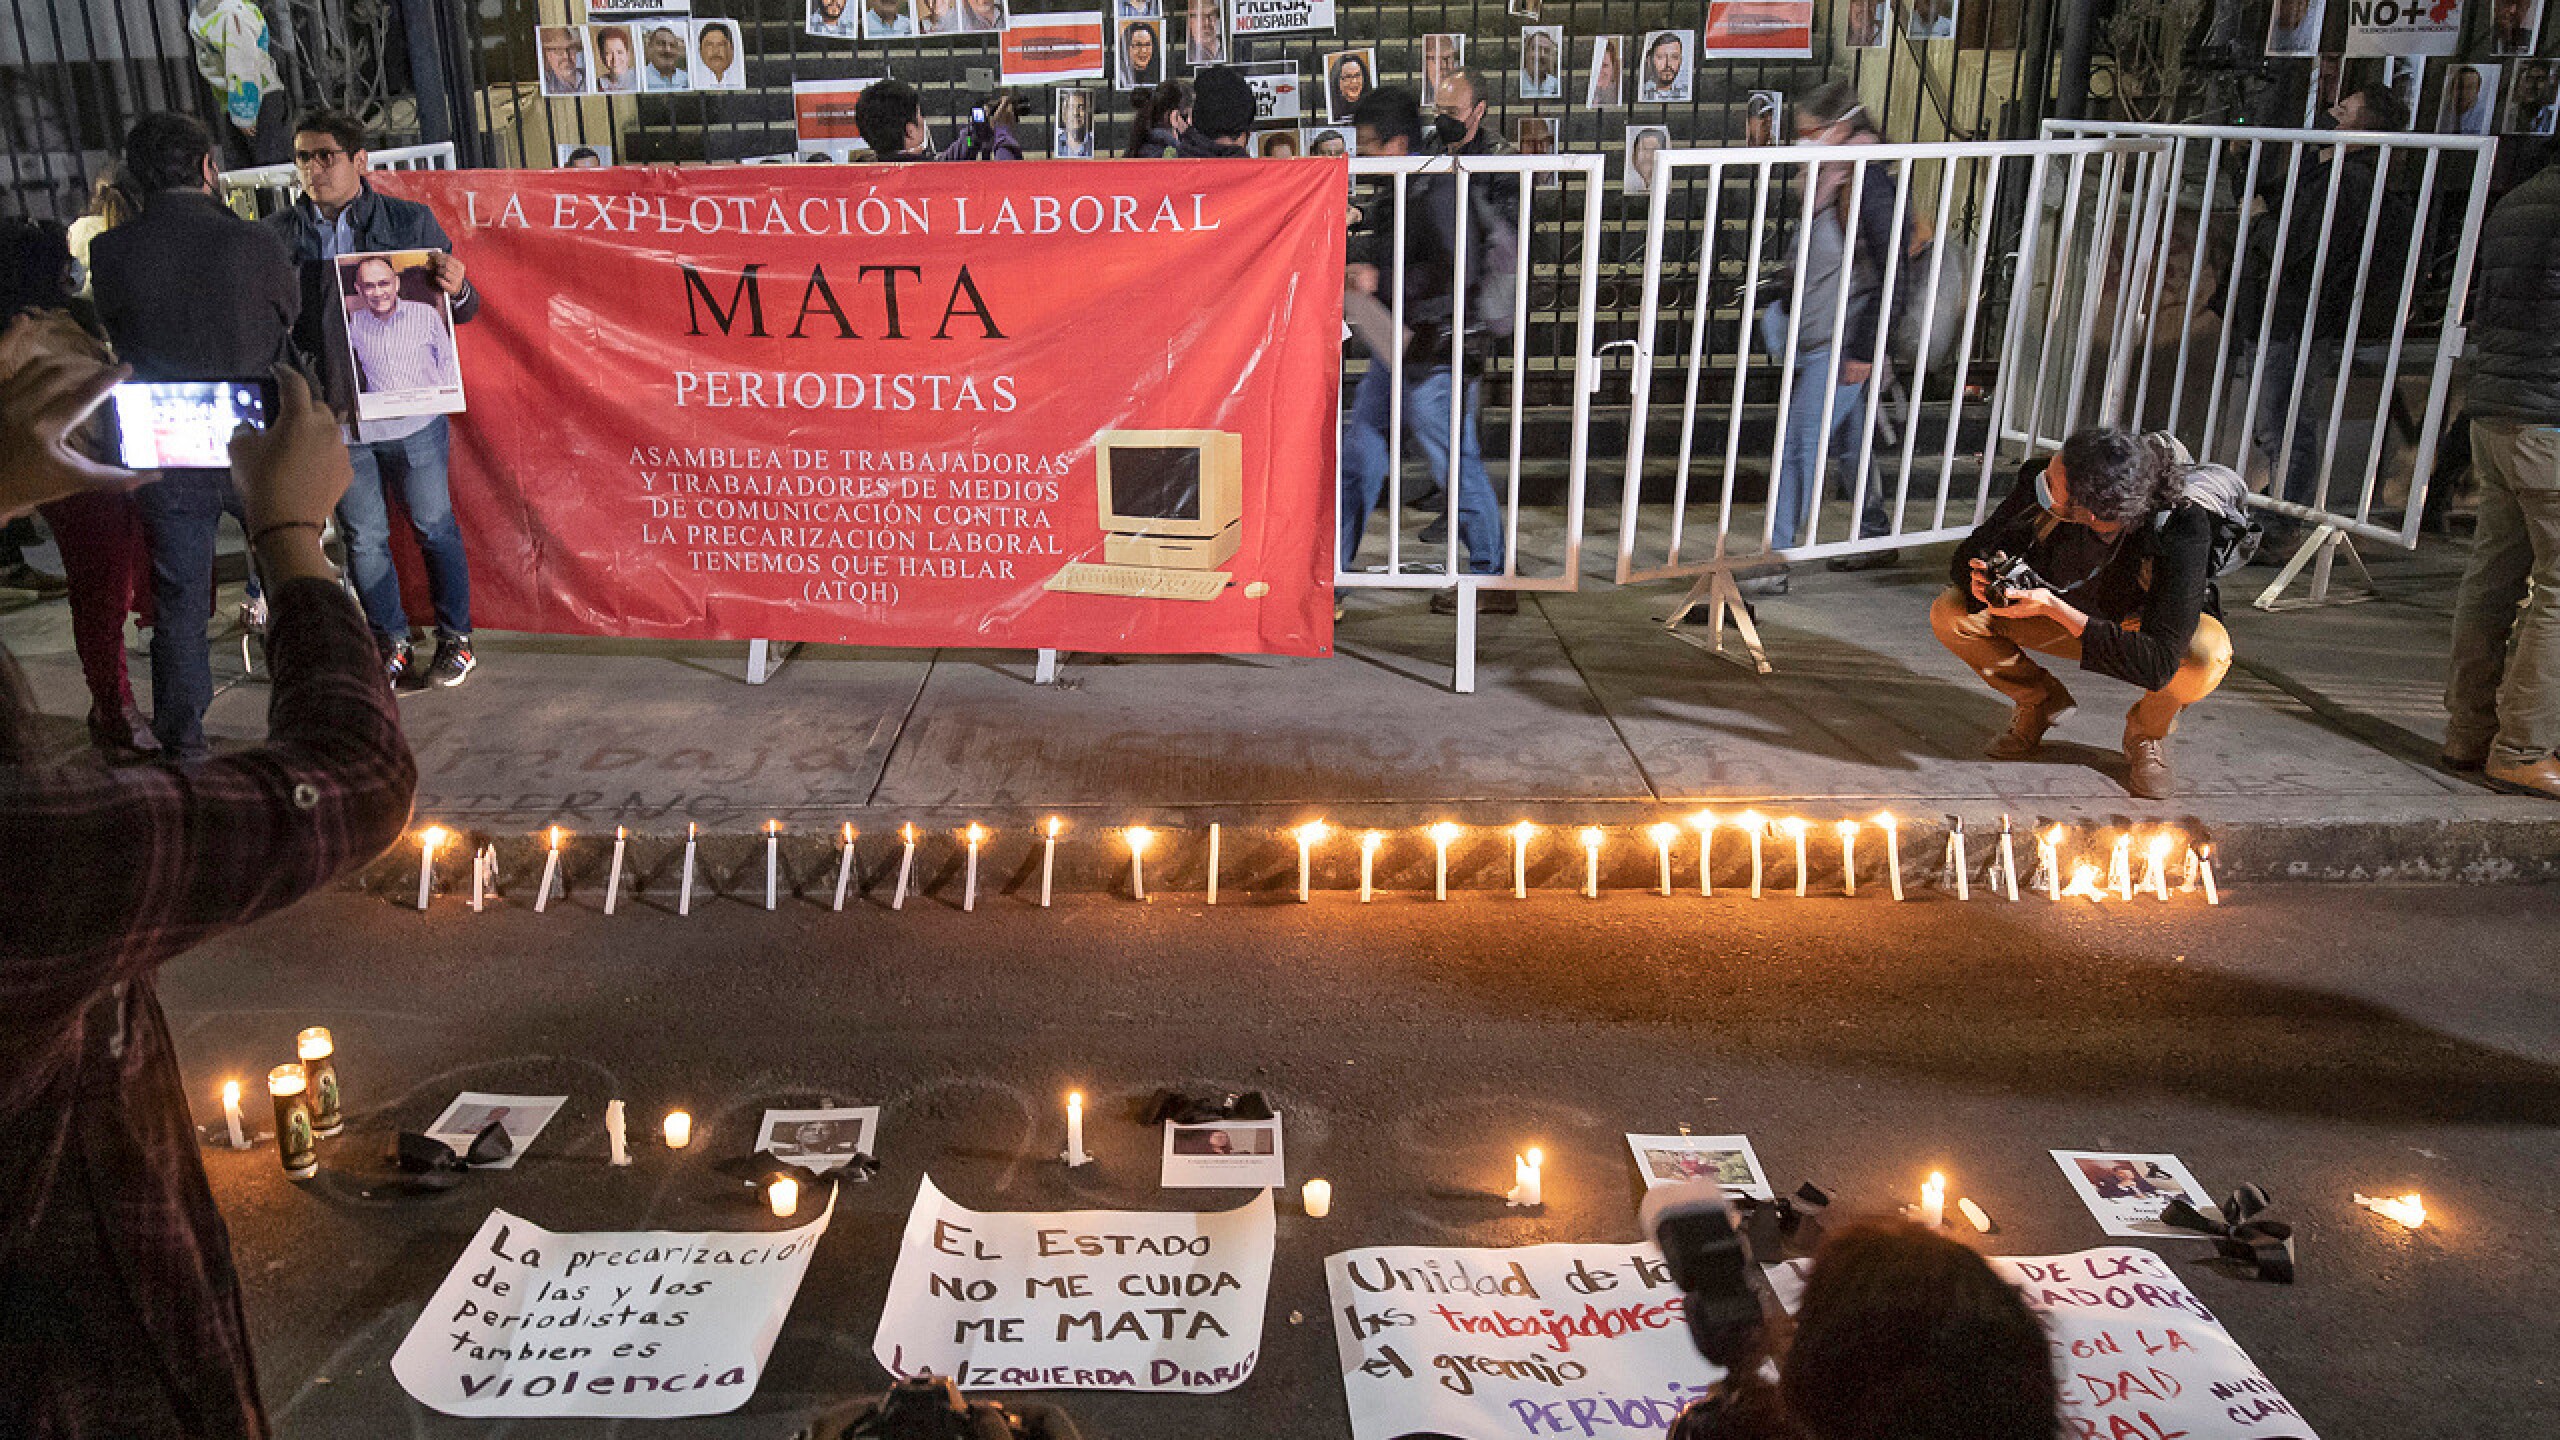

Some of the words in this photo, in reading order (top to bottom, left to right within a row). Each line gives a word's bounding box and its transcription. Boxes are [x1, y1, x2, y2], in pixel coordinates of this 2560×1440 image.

[465, 192, 531, 229] LA
[552, 186, 930, 235] EXPLOTACIÓN
[956, 194, 1222, 235] LABORAL
[679, 263, 1009, 340] MATA
[674, 371, 1018, 413] PERIODISTAS
[629, 446, 783, 470] ASAMBLEA
[794, 449, 829, 470] DE
[839, 450, 1070, 476] TRABAJADORAS
[640, 472, 658, 492] Y
[667, 473, 890, 499] TRABAJADORES
[902, 478, 937, 499] DE
[947, 479, 1059, 502] MEDIOS
[652, 500, 687, 519] DE
[697, 497, 923, 525] COMUNICACIÓN
[934, 505, 1051, 529] CONTRA
[641, 524, 677, 545] LA
[688, 523, 916, 552] PRECARIZACIÓN
[927, 531, 1063, 555] LABORAL
[688, 551, 821, 574] TENEMOS
[831, 554, 889, 579] QUE
[900, 557, 1015, 580] HABLAR
[803, 581, 899, 605] (ATQH)
[489, 1225, 541, 1268] La
[472, 1267, 511, 1297] de
[537, 1281, 588, 1302] las
[611, 1284, 631, 1306] y
[649, 1275, 712, 1297] los
[930, 1271, 997, 1302] NO
[1026, 1274, 1093, 1299] ME
[1118, 1271, 1241, 1298] CUIDA
[1347, 1257, 1541, 1300] Unidad
[1565, 1259, 1619, 1295] de
[2016, 1261, 2071, 1282] DE
[954, 1318, 1025, 1344] ME
[1056, 1307, 1230, 1343] MATA
[613, 1341, 661, 1359] es
[2136, 1329, 2199, 1356] LA
[1360, 1344, 1414, 1379] el
[1433, 1352, 1588, 1396] gremio
